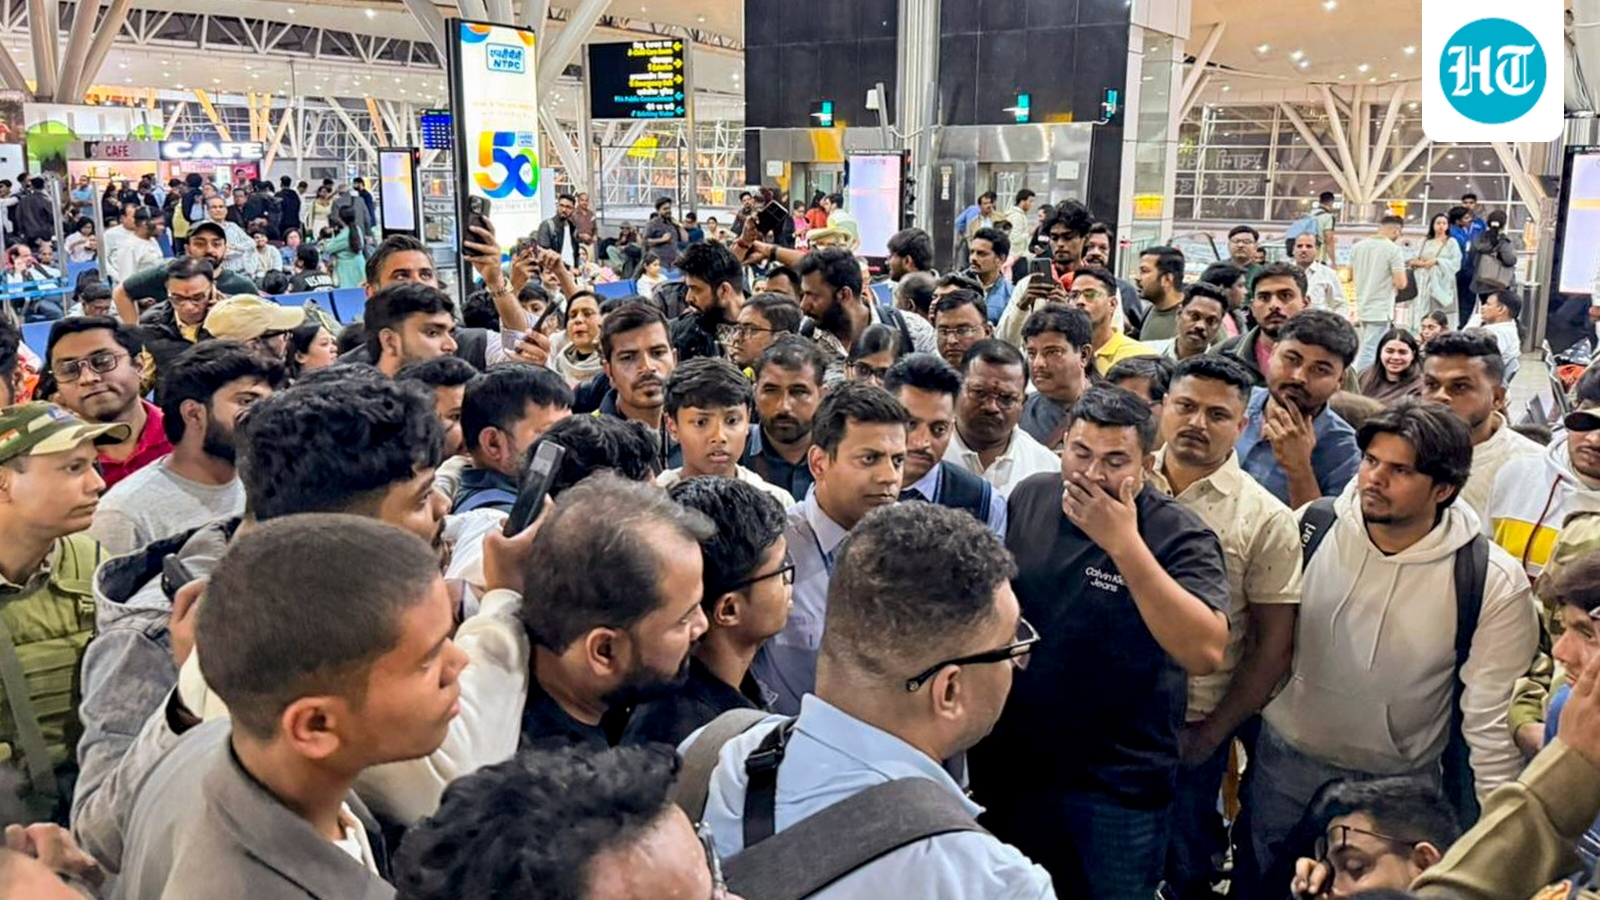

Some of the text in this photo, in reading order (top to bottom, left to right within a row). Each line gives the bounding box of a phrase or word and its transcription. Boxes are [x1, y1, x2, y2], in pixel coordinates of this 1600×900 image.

[493, 59, 521, 70] NTPC
[105, 145, 129, 157] CAFE
[162, 142, 264, 158] CAFE
[472, 130, 540, 199] 50
[1301, 522, 1317, 548] ari
[1085, 566, 1112, 582] Calvin
[1090, 578, 1118, 593] Jeans
